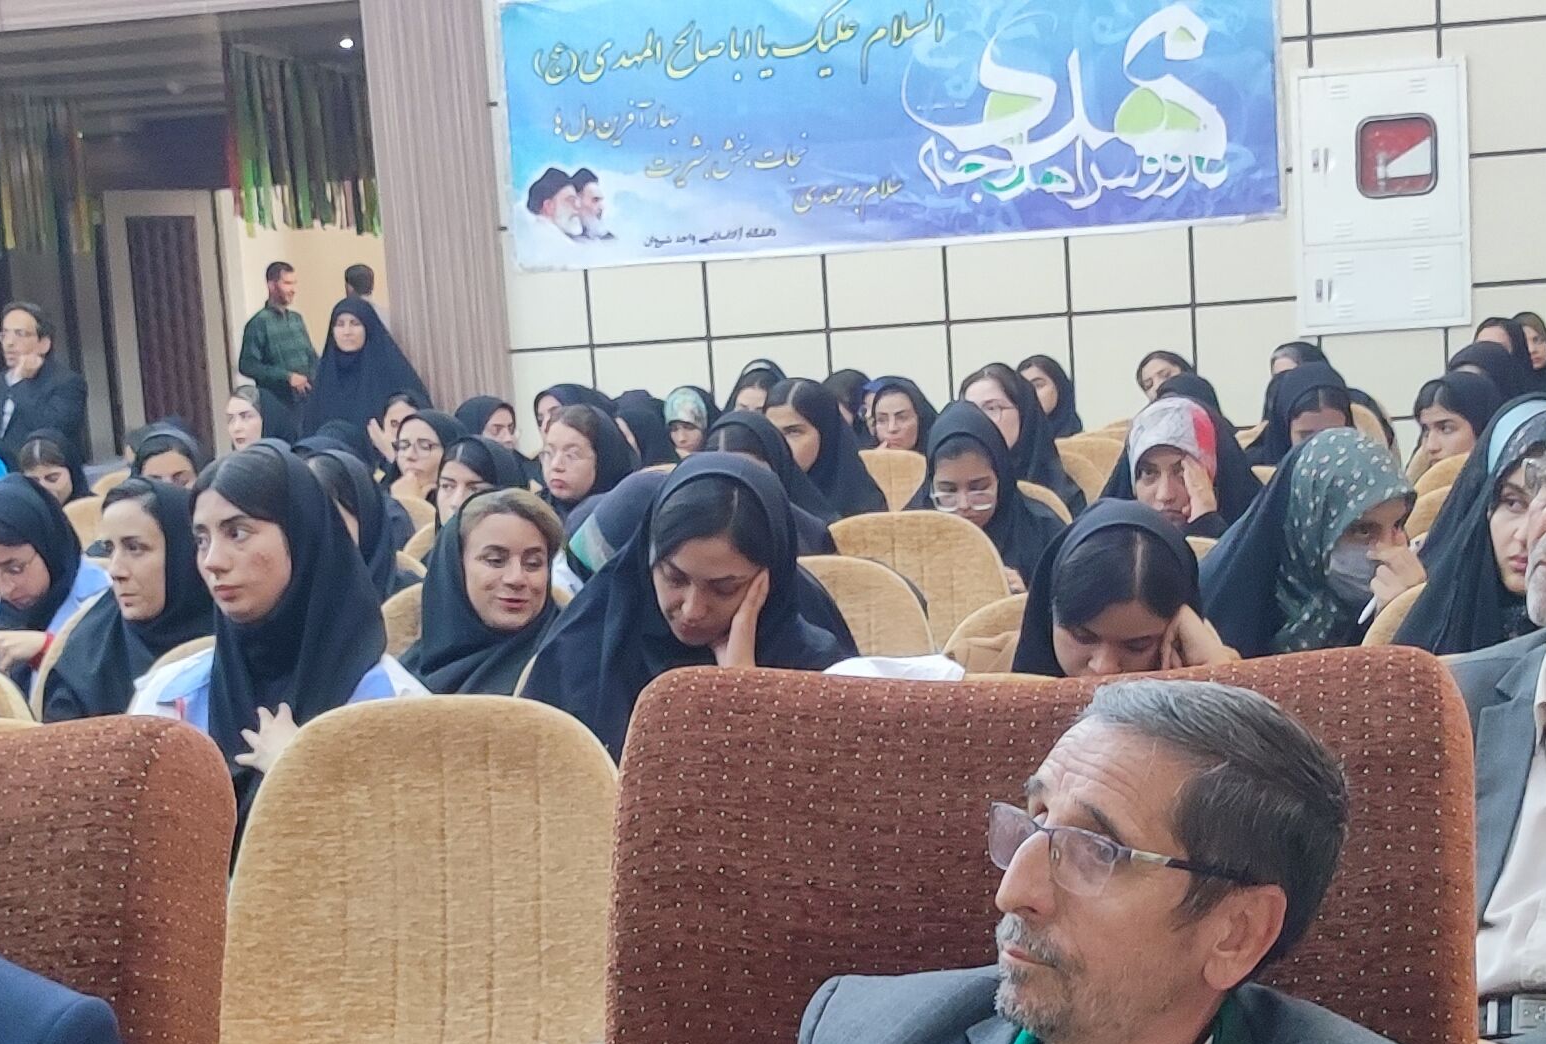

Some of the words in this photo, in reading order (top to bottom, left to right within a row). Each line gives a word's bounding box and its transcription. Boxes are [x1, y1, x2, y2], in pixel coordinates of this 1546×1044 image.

[578, 27, 662, 84] المهدی
[771, 0, 859, 77] علیک
[860, 0, 944, 84] السلام
[754, 131, 808, 183] نجات
[793, 185, 844, 214] مهدی
[859, 176, 904, 223] سلام
